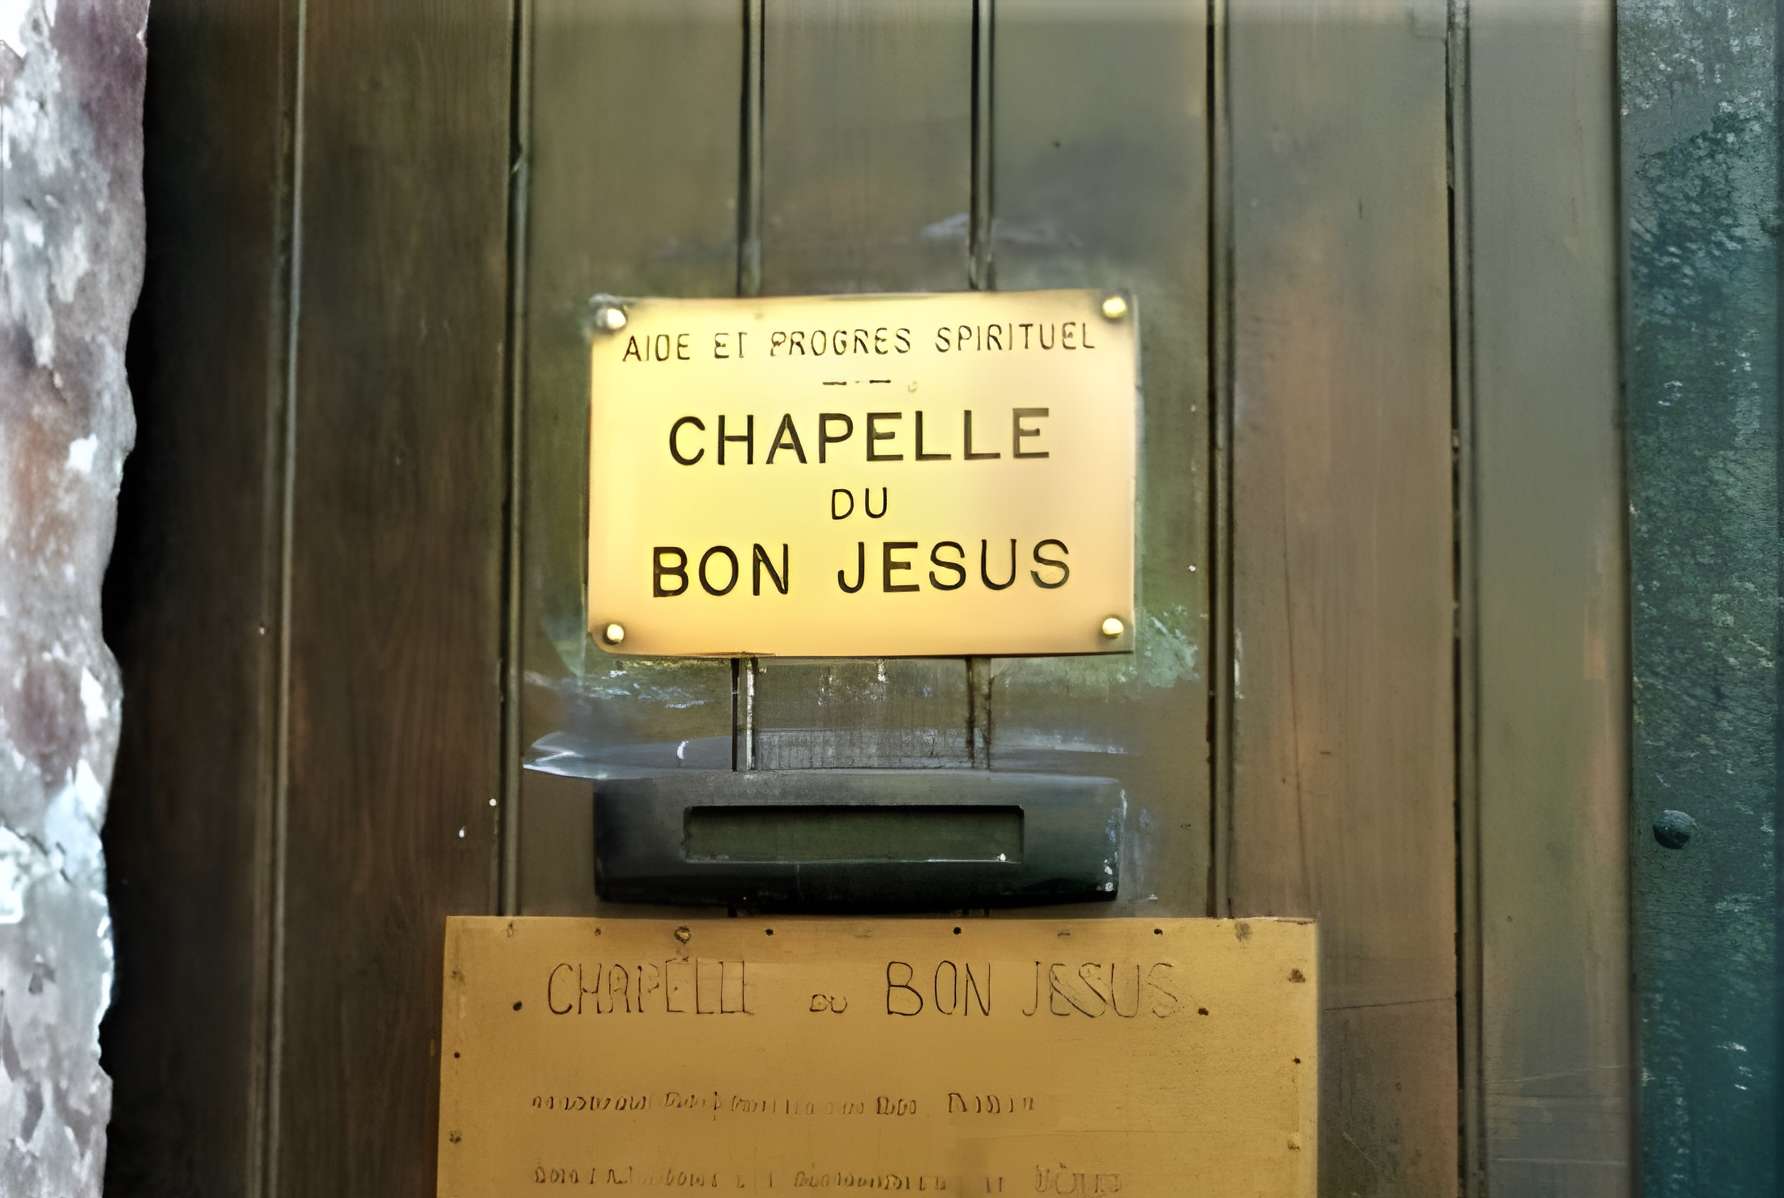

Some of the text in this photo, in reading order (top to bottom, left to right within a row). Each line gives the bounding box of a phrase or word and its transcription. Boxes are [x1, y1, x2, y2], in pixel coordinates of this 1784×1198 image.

[622, 332, 691, 362] AIDE
[714, 331, 747, 359] ET
[935, 321, 1096, 352] SPIRITUEL
[669, 407, 1050, 466] CHAPELLE
[831, 487, 888, 520] DU
[652, 538, 1071, 598] BON JESUS
[886, 960, 991, 1017] BON
[1022, 960, 1179, 1018] JESUS
